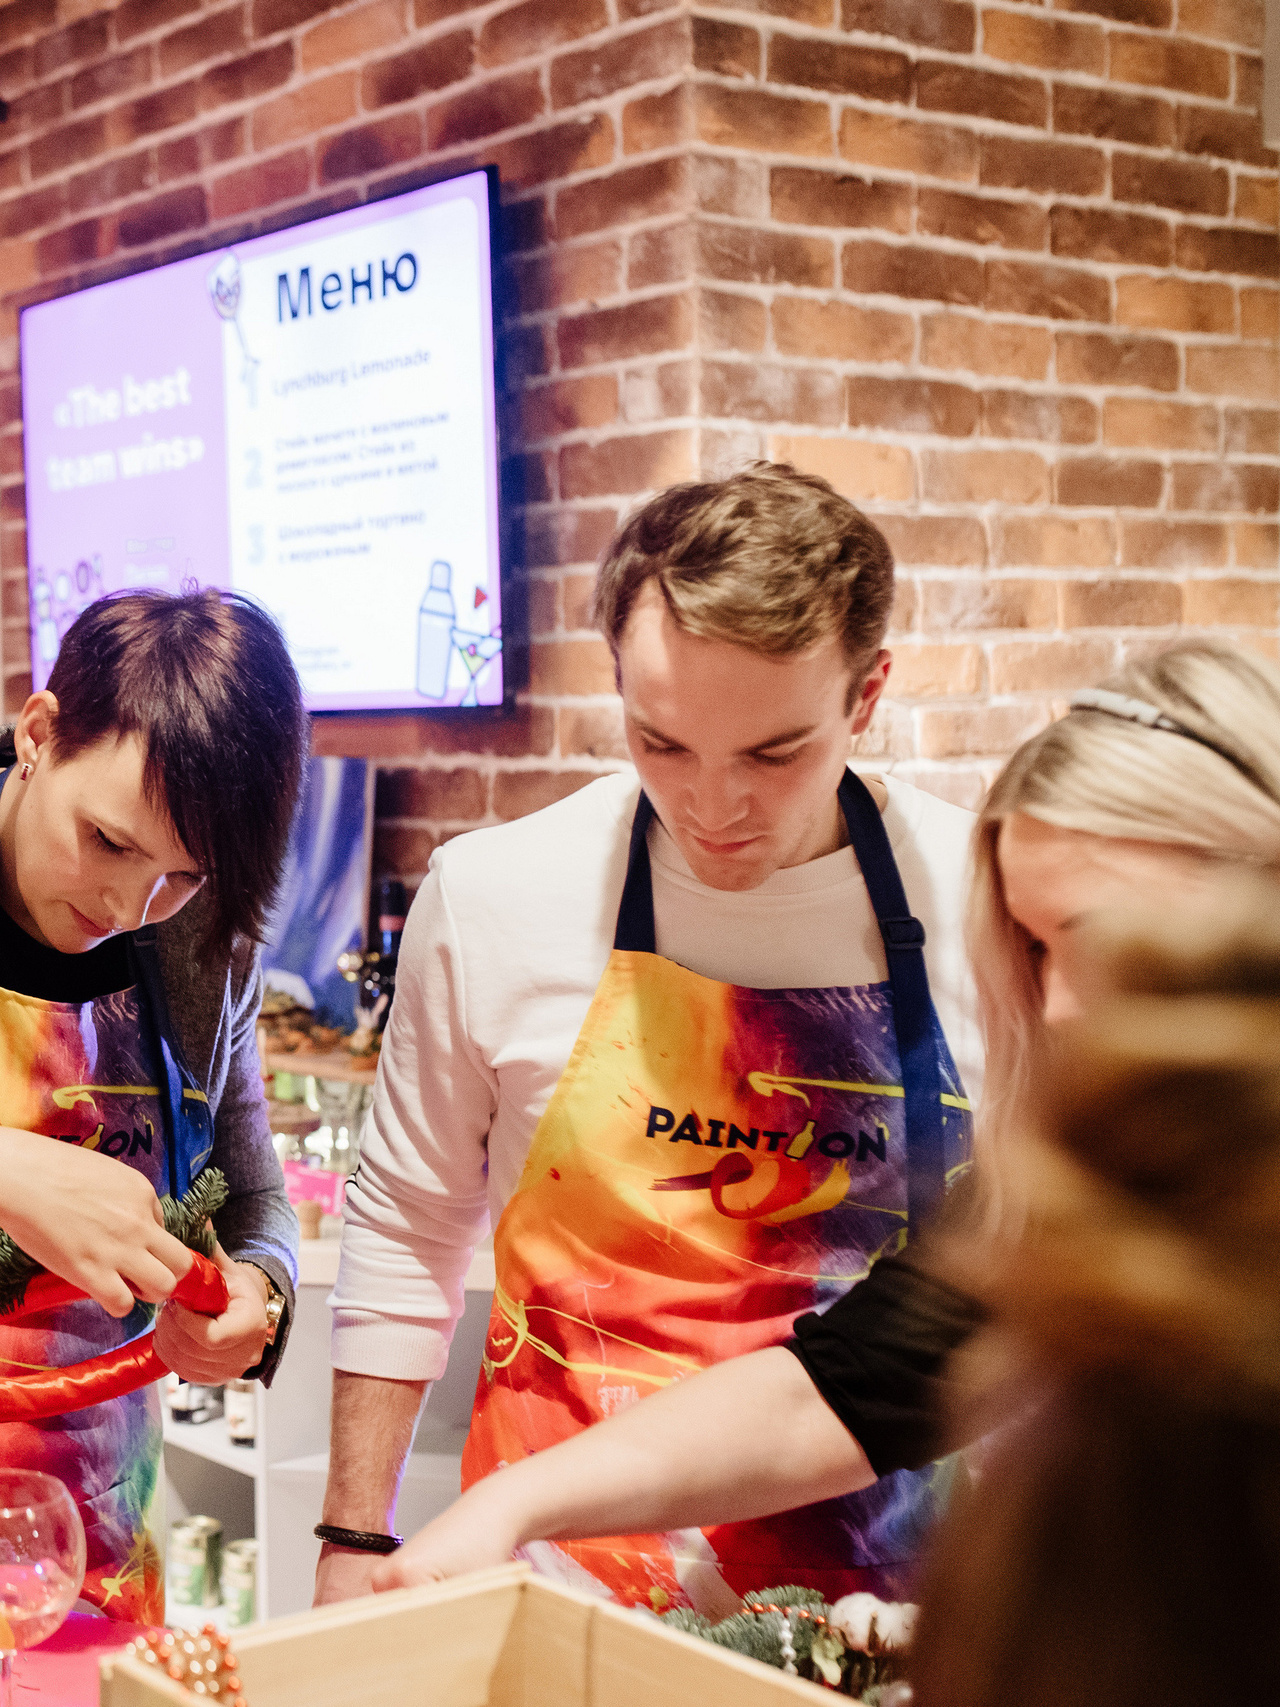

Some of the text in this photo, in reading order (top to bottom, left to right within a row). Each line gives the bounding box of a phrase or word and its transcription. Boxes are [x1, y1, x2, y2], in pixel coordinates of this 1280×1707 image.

[278, 253, 416, 322] Меню
[122, 367, 191, 417] best
[274, 349, 430, 396] Lynchburg Lemonade
[47, 434, 116, 491] team
[245, 448, 263, 489] 2
